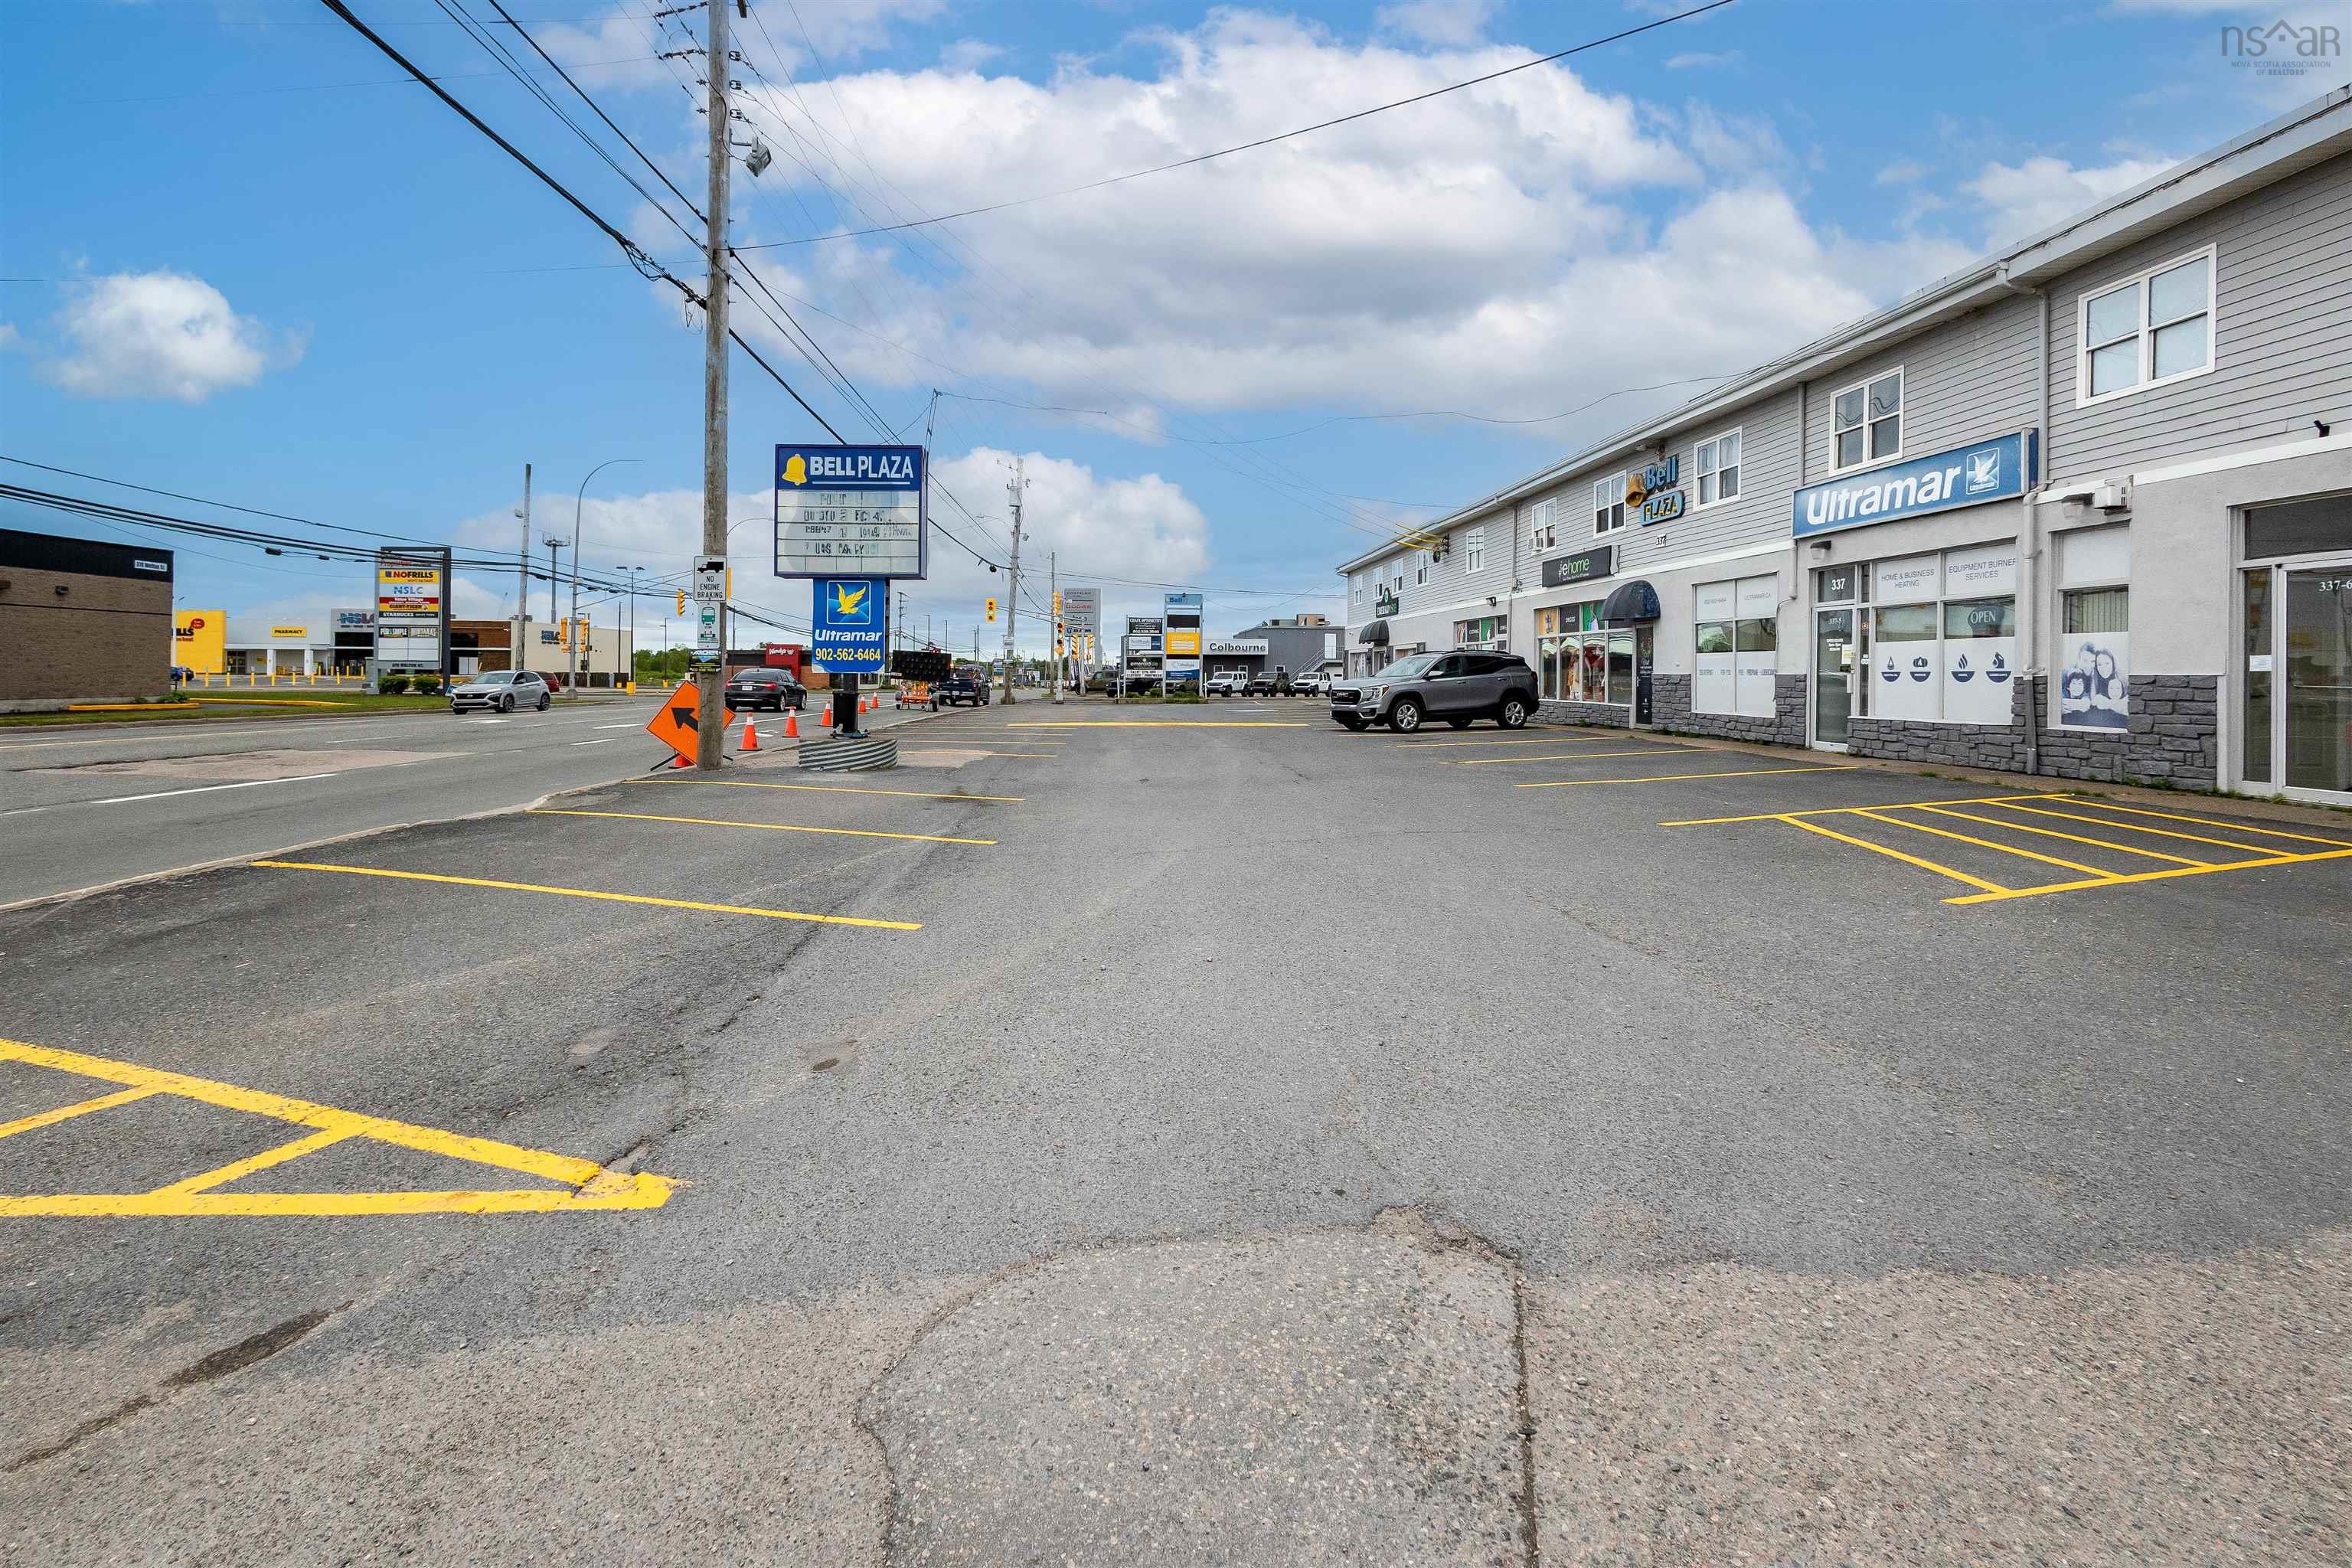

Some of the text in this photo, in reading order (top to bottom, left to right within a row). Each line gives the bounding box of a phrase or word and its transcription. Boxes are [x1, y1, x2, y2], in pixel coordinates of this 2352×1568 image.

[809, 456, 914, 479] BELL PLAZA
[1645, 456, 1677, 491] Bell
[1806, 466, 1962, 525] Ultramar
[1643, 495, 1678, 522] PLAZA
[1949, 561, 1987, 573] EQUIPMENT
[1881, 573, 1899, 582] HOME
[1904, 569, 1935, 579] BUSINESS
[1965, 570, 1999, 581] SERVICES
[1831, 578, 1845, 591] 337
[1894, 580, 1920, 589] HEATING
[1970, 610, 1996, 624] OPEN
[815, 629, 882, 642] Ultramar
[1209, 642, 1266, 651] Colbourne
[815, 648, 881, 661] 902-562-6464
